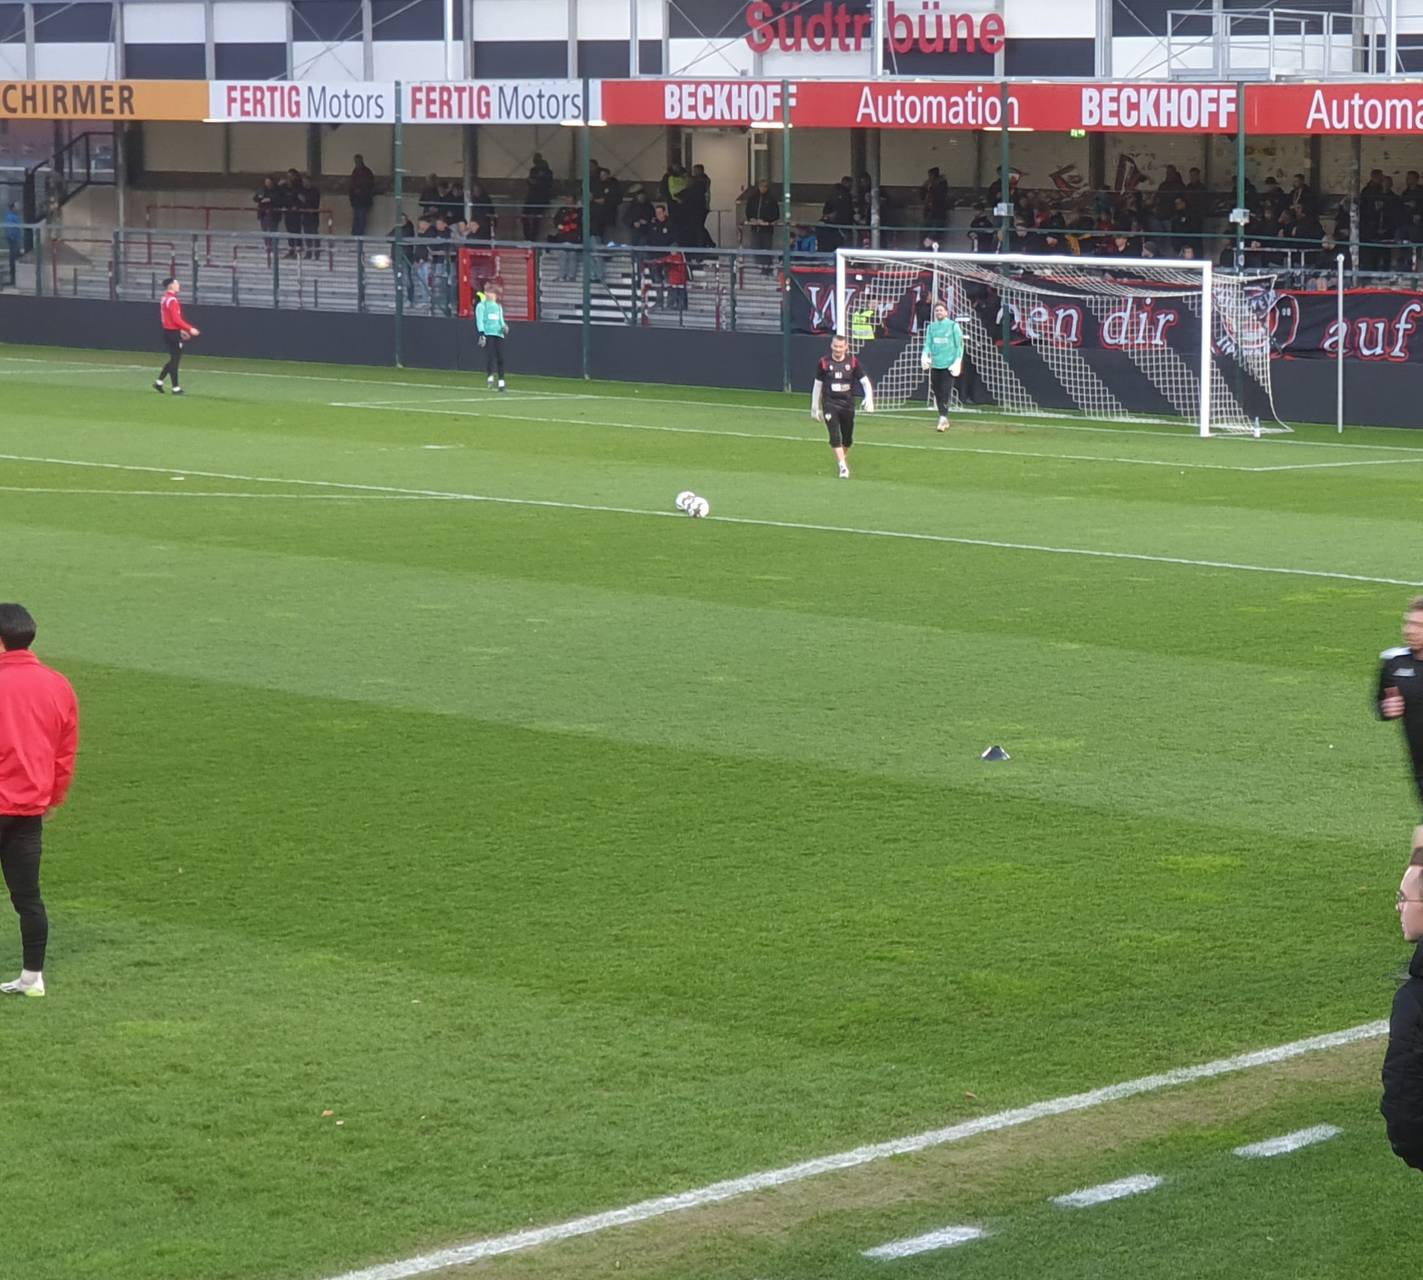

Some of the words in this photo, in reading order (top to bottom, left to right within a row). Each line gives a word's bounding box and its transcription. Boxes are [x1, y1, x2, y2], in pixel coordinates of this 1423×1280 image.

[745, 0, 1006, 54] Südtrbüne
[2, 84, 135, 115] CHIRMER
[226, 84, 300, 118] FERTIG
[307, 85, 385, 119] Motors
[411, 84, 491, 119] FERTIG
[499, 85, 582, 119] Motors
[856, 86, 1019, 125] Automation
[1081, 87, 1237, 128] BECKHOFF
[1102, 295, 1175, 345] dir
[1322, 302, 1422, 358] auf
